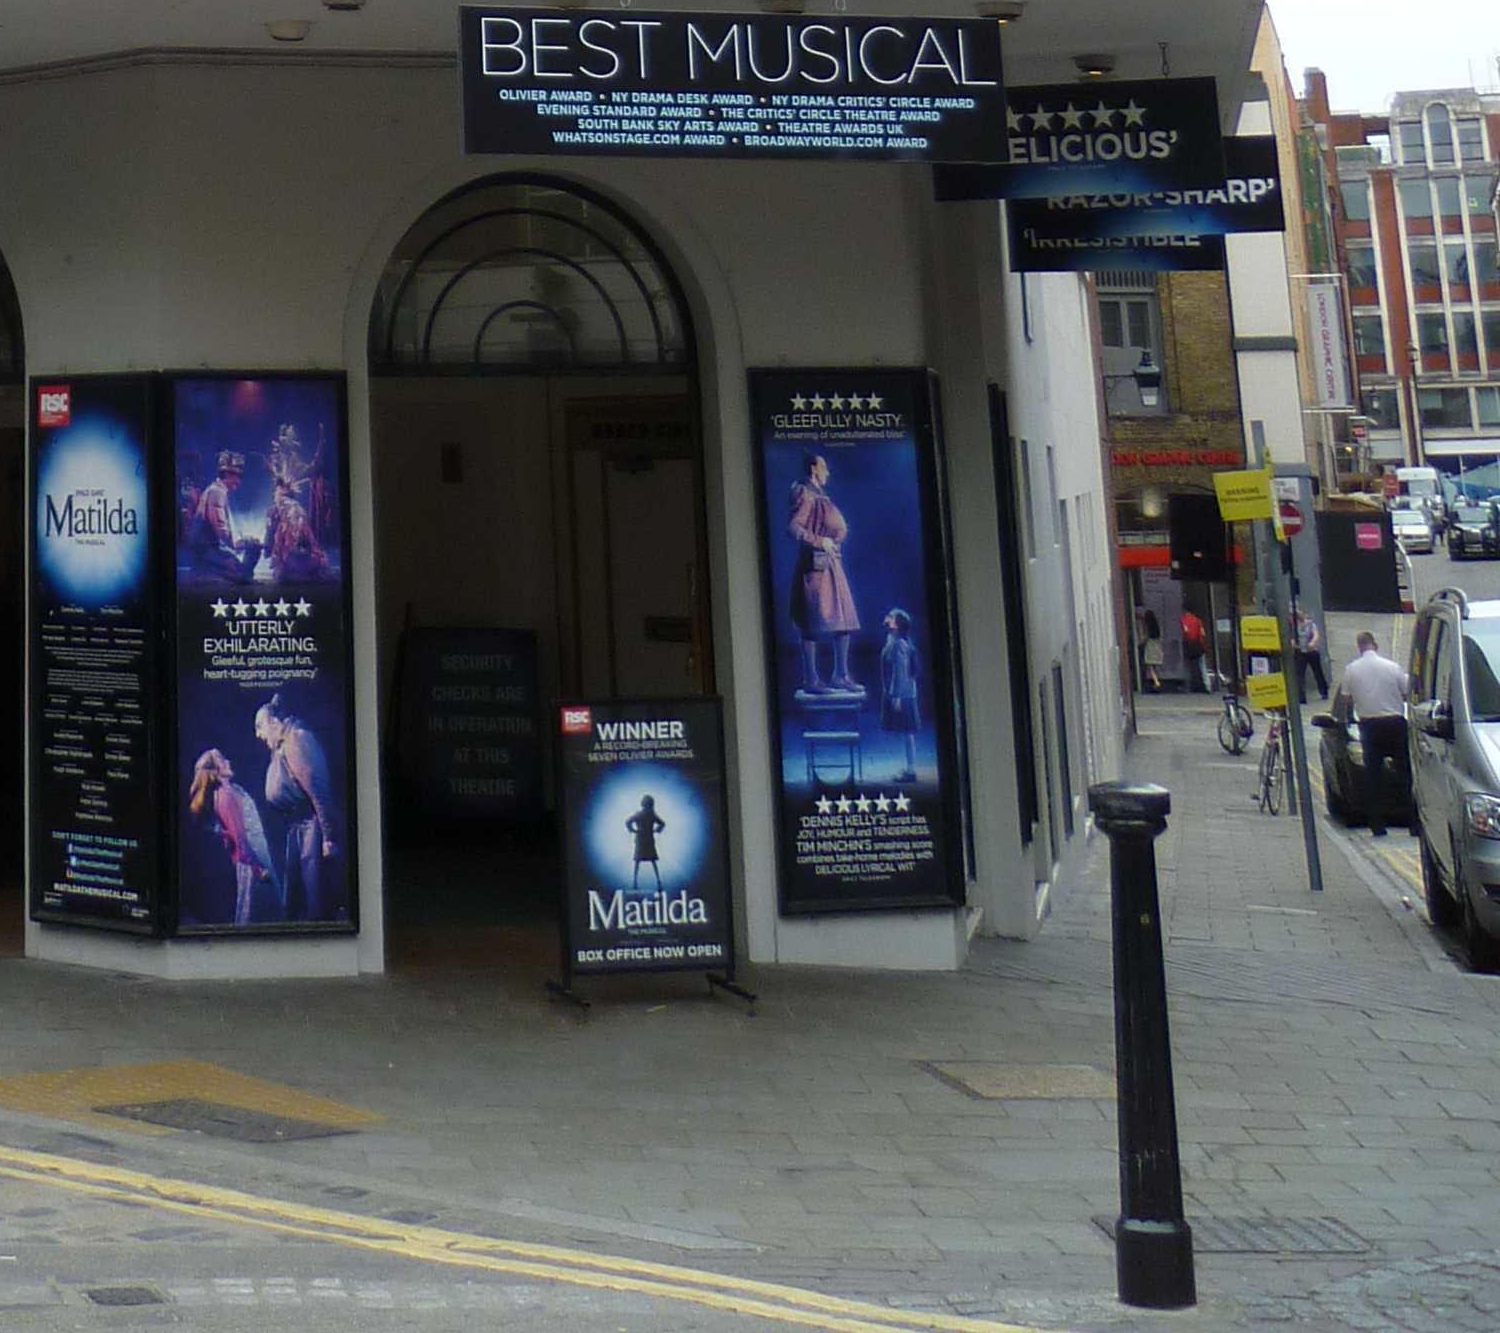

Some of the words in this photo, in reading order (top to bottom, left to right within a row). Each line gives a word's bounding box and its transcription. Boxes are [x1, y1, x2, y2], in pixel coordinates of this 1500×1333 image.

[481, 17, 662, 79] BEST
[687, 22, 997, 85] MUSICAL
[499, 89, 547, 101] OLIVIER
[550, 90, 592, 102] AWARD
[611, 92, 628, 102] NY
[631, 92, 674, 104] DRAMA
[677, 93, 709, 104] DESK
[711, 94, 753, 106] AWARD
[772, 95, 789, 106] NY
[792, 95, 834, 107] DRAMA
[837, 96, 887, 108] CRITICS'
[889, 97, 931, 108] CIRCLE
[933, 98, 975, 109] AWARD
[537, 104, 589, 115] EVENING
[592, 105, 657, 117] STANDARD
[660, 106, 702, 118] AWARD
[721, 108, 744, 119] THE
[747, 108, 797, 120] CRITICS'
[799, 109, 841, 120] CIRCLE
[843, 110, 897, 121] THEATRE
[899, 111, 941, 122] AWARD
[577, 118, 619, 130] SOUTH
[621, 119, 655, 130] BANK
[657, 120, 681, 131] SKY
[683, 121, 714, 132] ARTS
[717, 122, 759, 133] AWARD
[777, 122, 830, 133] THEATRE
[833, 123, 884, 134] AWARDS
[887, 124, 904, 134] UK
[552, 131, 680, 144] WHATSONSTAGE.COM
[683, 134, 725, 145] AWARD
[744, 135, 883, 148] BROADWAYWORLD.COM
[886, 137, 928, 148] AWARD
[1008, 130, 1178, 164] ELICIOUS'
[41, 393, 69, 412] RSC
[45, 494, 138, 537] Matilda
[203, 637, 318, 654] EXHILARATING.
[441, 654, 513, 671] SECURITY
[203, 668, 267, 681] heart-tugging
[432, 685, 491, 703] CHECKS
[495, 685, 526, 703] ARE
[447, 716, 532, 733] OPERATION
[564, 711, 589, 724] RSC
[596, 720, 684, 741] WINNER
[452, 747, 471, 764] AT
[475, 747, 509, 765] THIS
[587, 751, 618, 762] SEVEN
[619, 750, 655, 761] OLIVIER
[655, 749, 694, 760] AWARDS
[449, 777, 515, 796] THEATRE
[795, 841, 815, 854] TIM
[815, 864, 860, 875] DELICIOUS
[861, 862, 896, 873] LYRICAL
[587, 889, 709, 931] Matilda
[577, 949, 604, 963] BOX
[606, 947, 651, 961] OFFICE
[653, 945, 685, 959] NOW
[687, 944, 723, 957] OPEN
